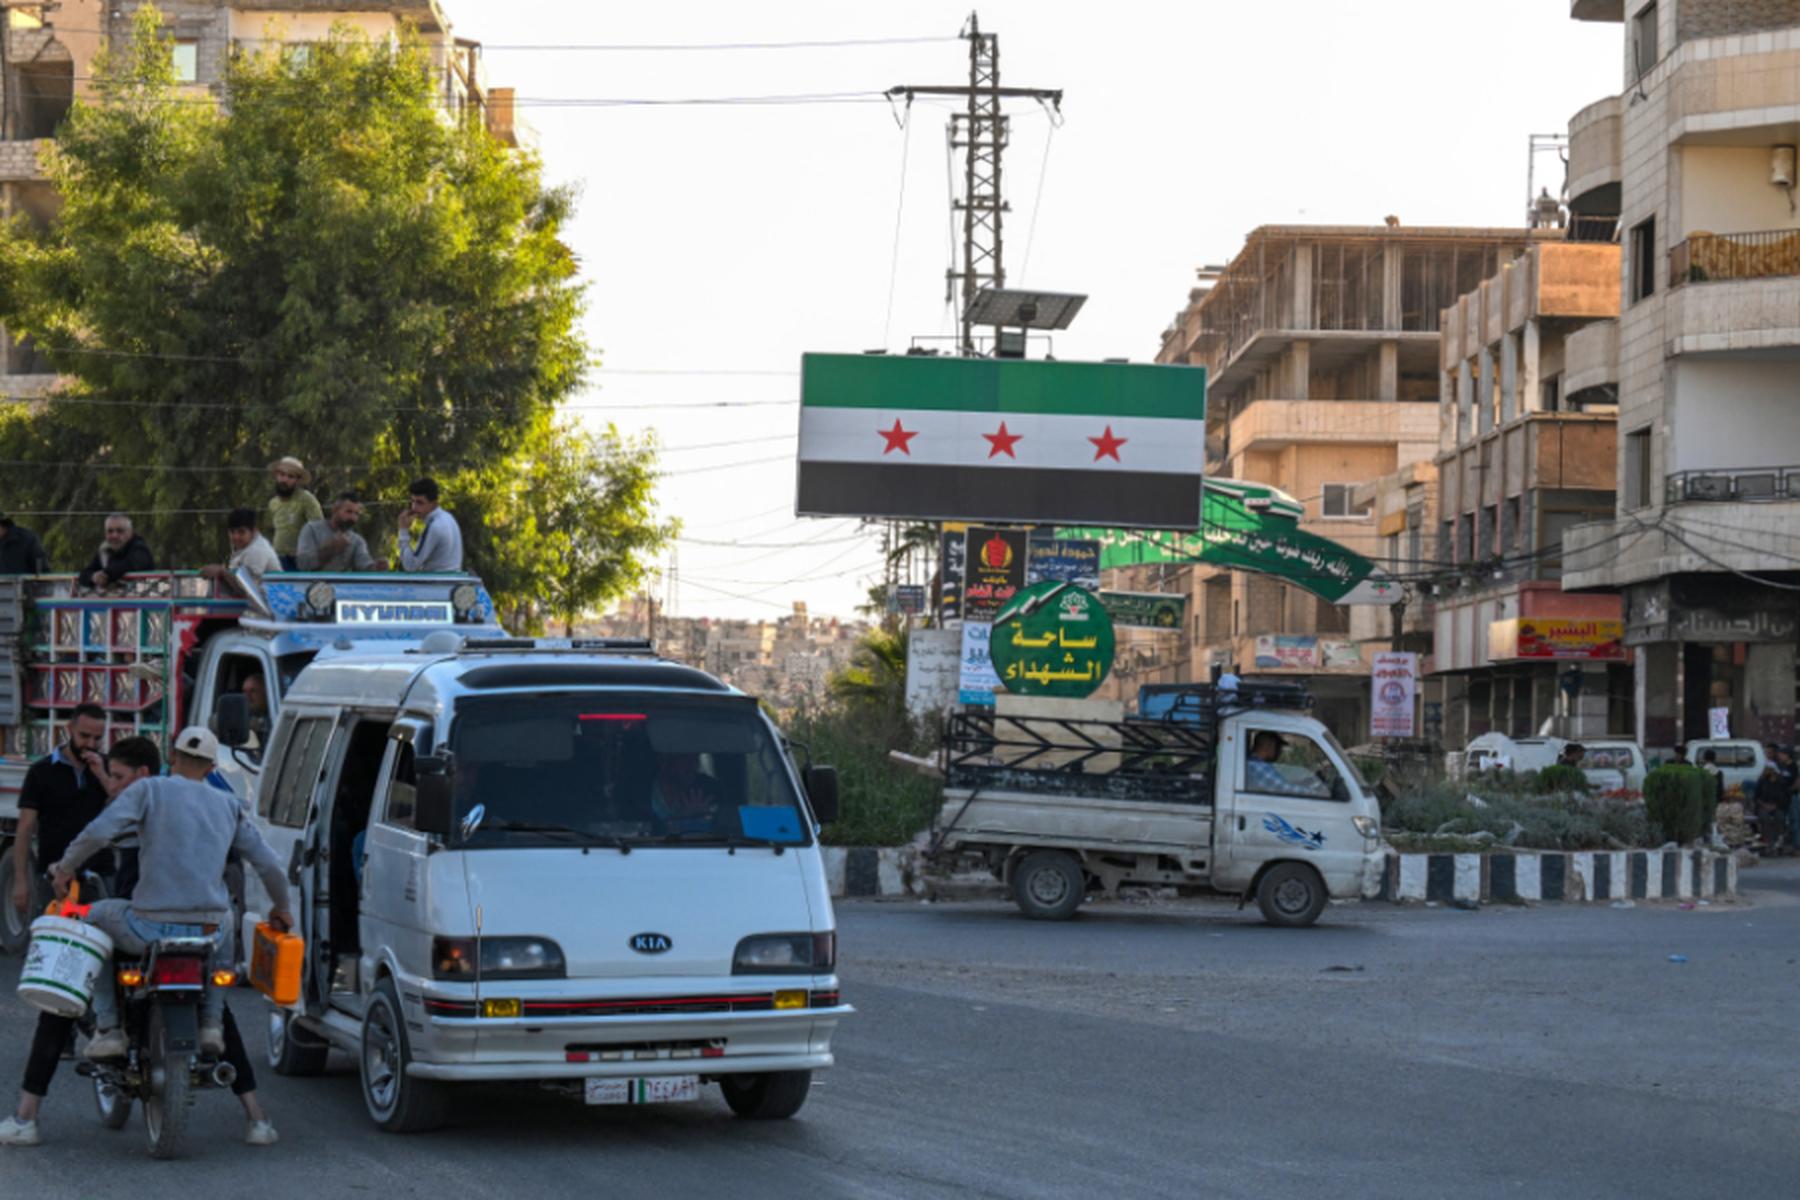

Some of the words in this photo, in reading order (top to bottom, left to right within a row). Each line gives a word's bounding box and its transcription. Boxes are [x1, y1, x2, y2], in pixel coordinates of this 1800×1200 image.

[1011, 621, 1097, 647] ساحة
[1004, 651, 1101, 685] الشهداء
[635, 936, 667, 949] KIA
